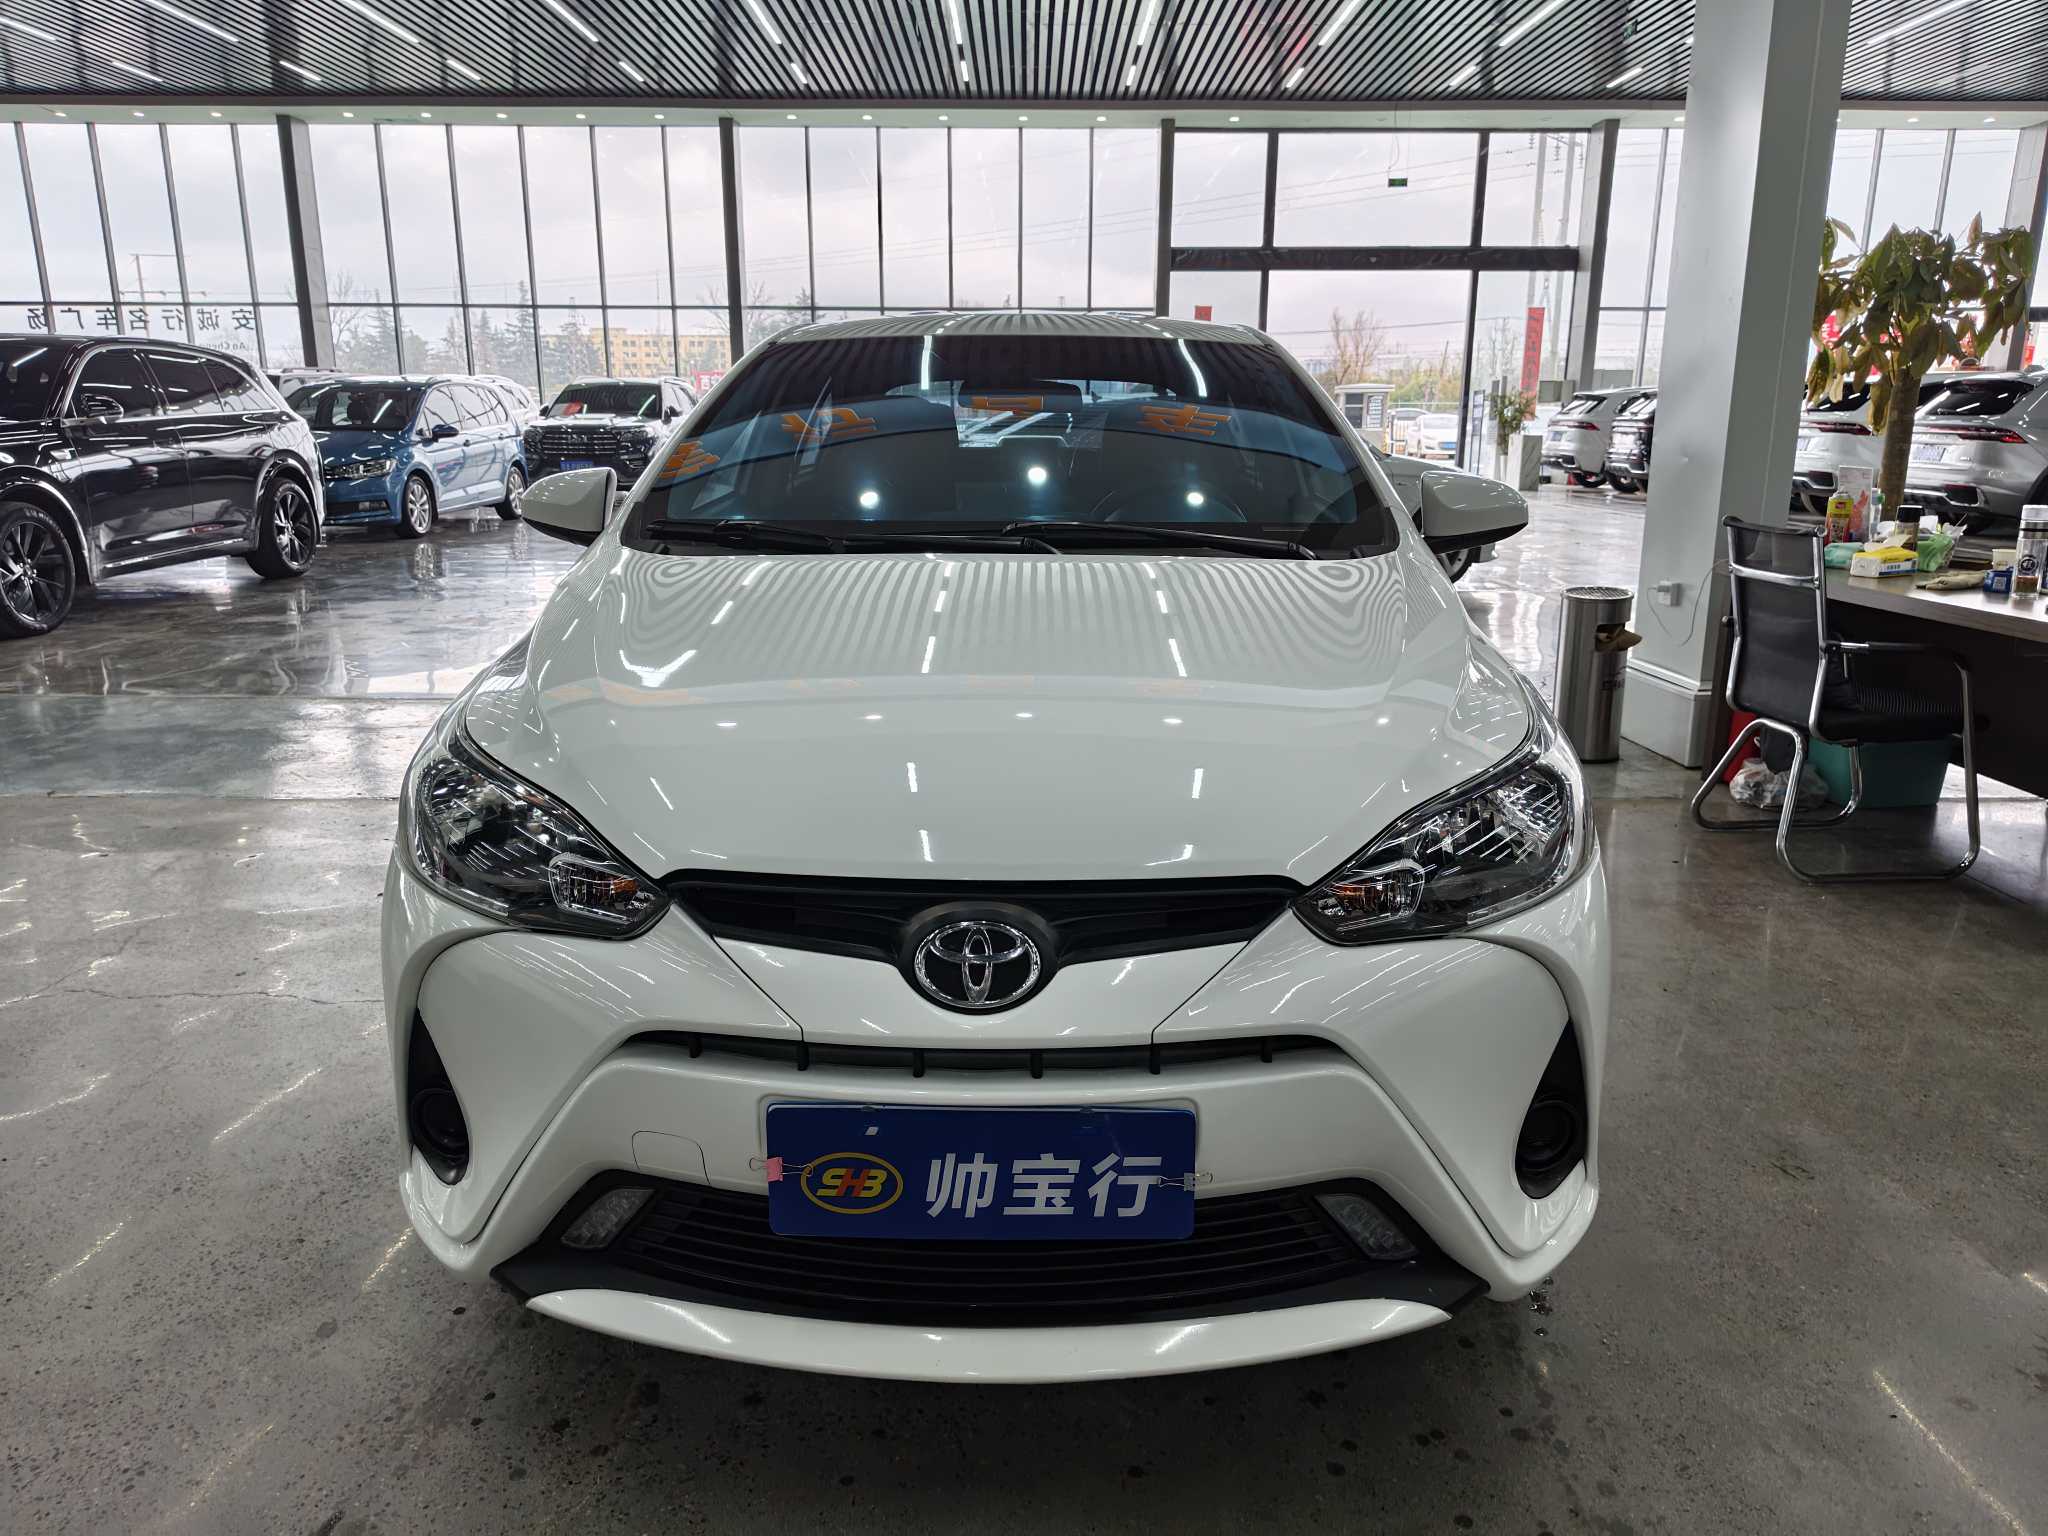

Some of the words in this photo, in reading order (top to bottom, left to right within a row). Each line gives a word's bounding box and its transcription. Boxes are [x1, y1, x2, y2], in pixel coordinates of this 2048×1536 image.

[816, 1167, 887, 1198] SHB
[925, 1152, 1163, 1218] 帅宝行
